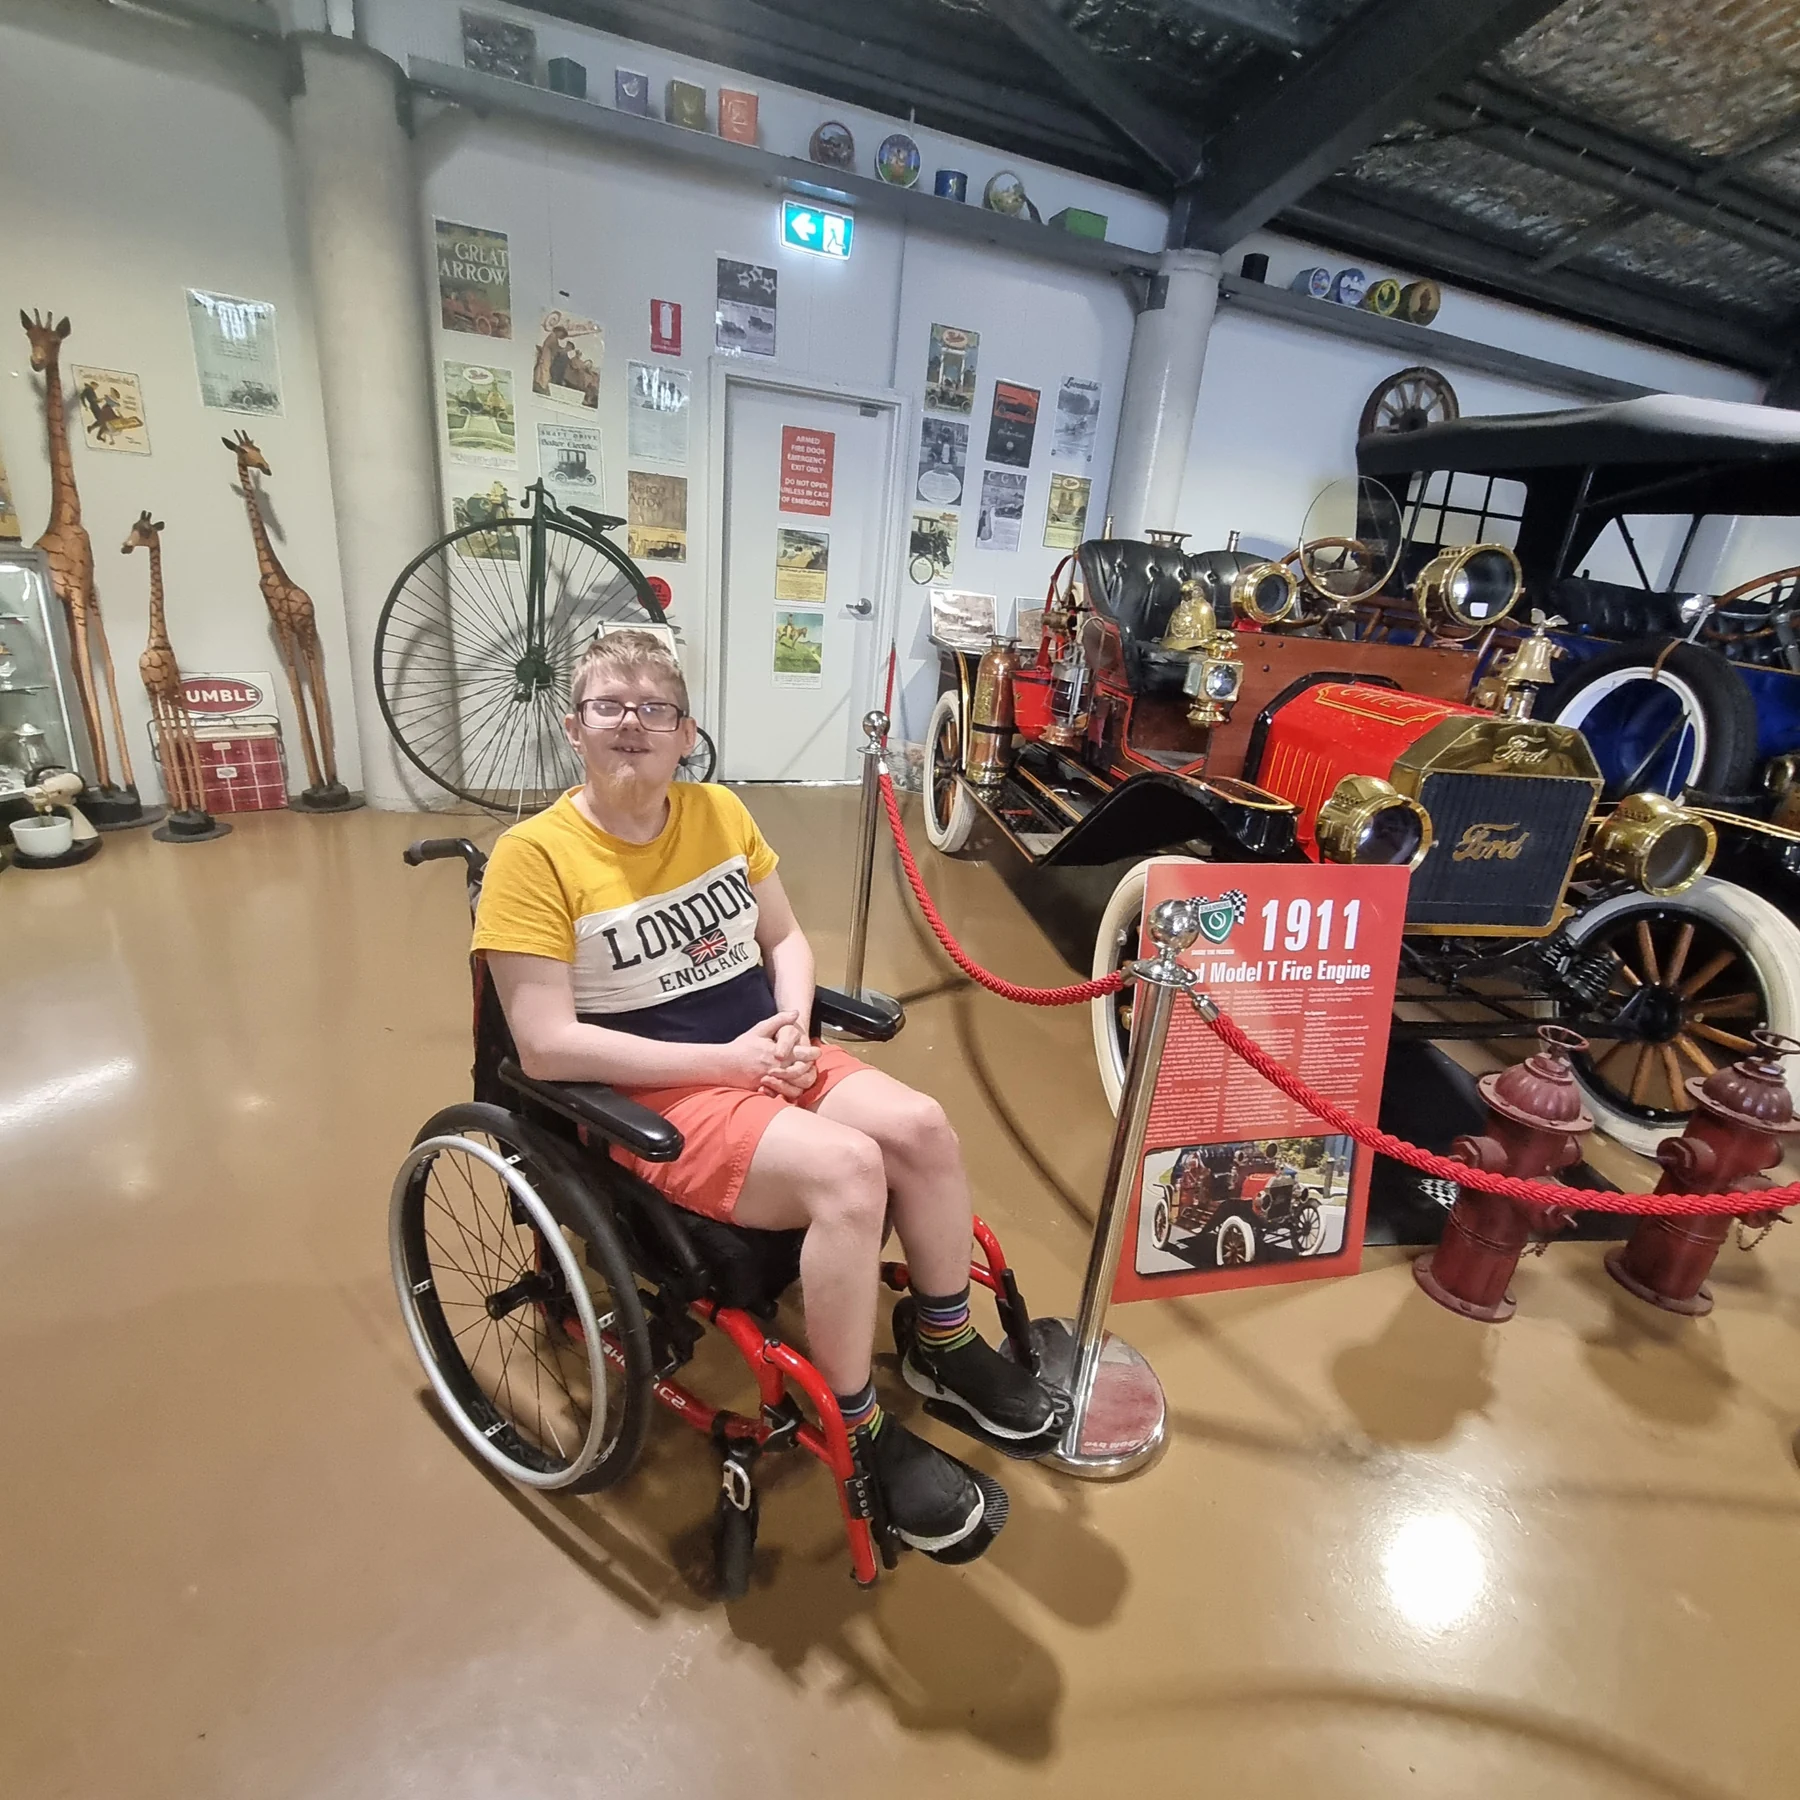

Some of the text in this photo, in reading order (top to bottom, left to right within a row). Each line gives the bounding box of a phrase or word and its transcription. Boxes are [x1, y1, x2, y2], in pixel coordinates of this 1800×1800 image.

[455, 242, 507, 267] GREAT
[440, 258, 507, 286] ARROW
[796, 435, 820, 445] ARMED
[787, 453, 827, 465] EMERGENCY
[791, 445, 825, 456] FIRE DOOR
[791, 464, 823, 474] EXIT ONLY
[781, 487, 830, 499] UNLESS IN CASE
[785, 477, 828, 490] DO NOT OPEN
[791, 497, 829, 508] EMERGENCY
[186, 688, 258, 704] UMBLE
[1492, 734, 1549, 764] Ford
[1452, 822, 1531, 862] Ford
[603, 868, 757, 970] LONDON
[1261, 899, 1361, 951] 1911
[1210, 963, 1262, 983] Model
[1267, 961, 1277, 981] T
[1281, 960, 1312, 980] Fire
[1317, 959, 1371, 984] Engine
[659, 1387, 687, 1410] C2
